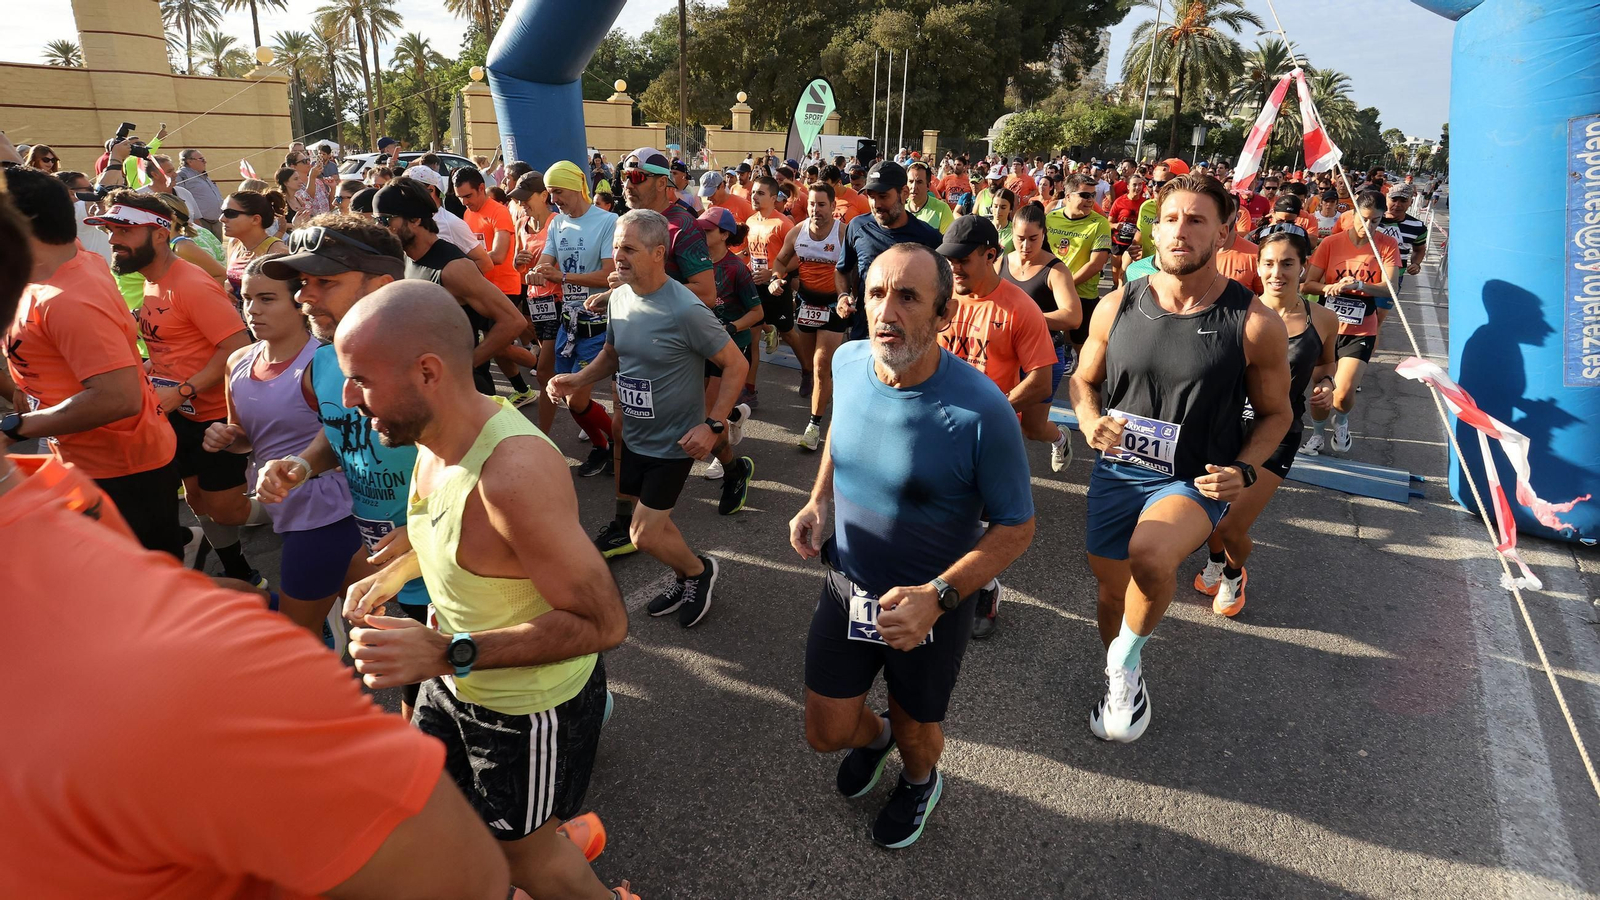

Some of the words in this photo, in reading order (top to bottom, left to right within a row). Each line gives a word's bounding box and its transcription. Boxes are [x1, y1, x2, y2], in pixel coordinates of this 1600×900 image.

[567, 284, 582, 293] 958
[535, 303, 549, 313] 959
[1334, 305, 1355, 316] 757
[806, 310, 821, 320] 139
[1125, 433, 1161, 458] 021
[349, 463, 406, 488] MARATÓN
